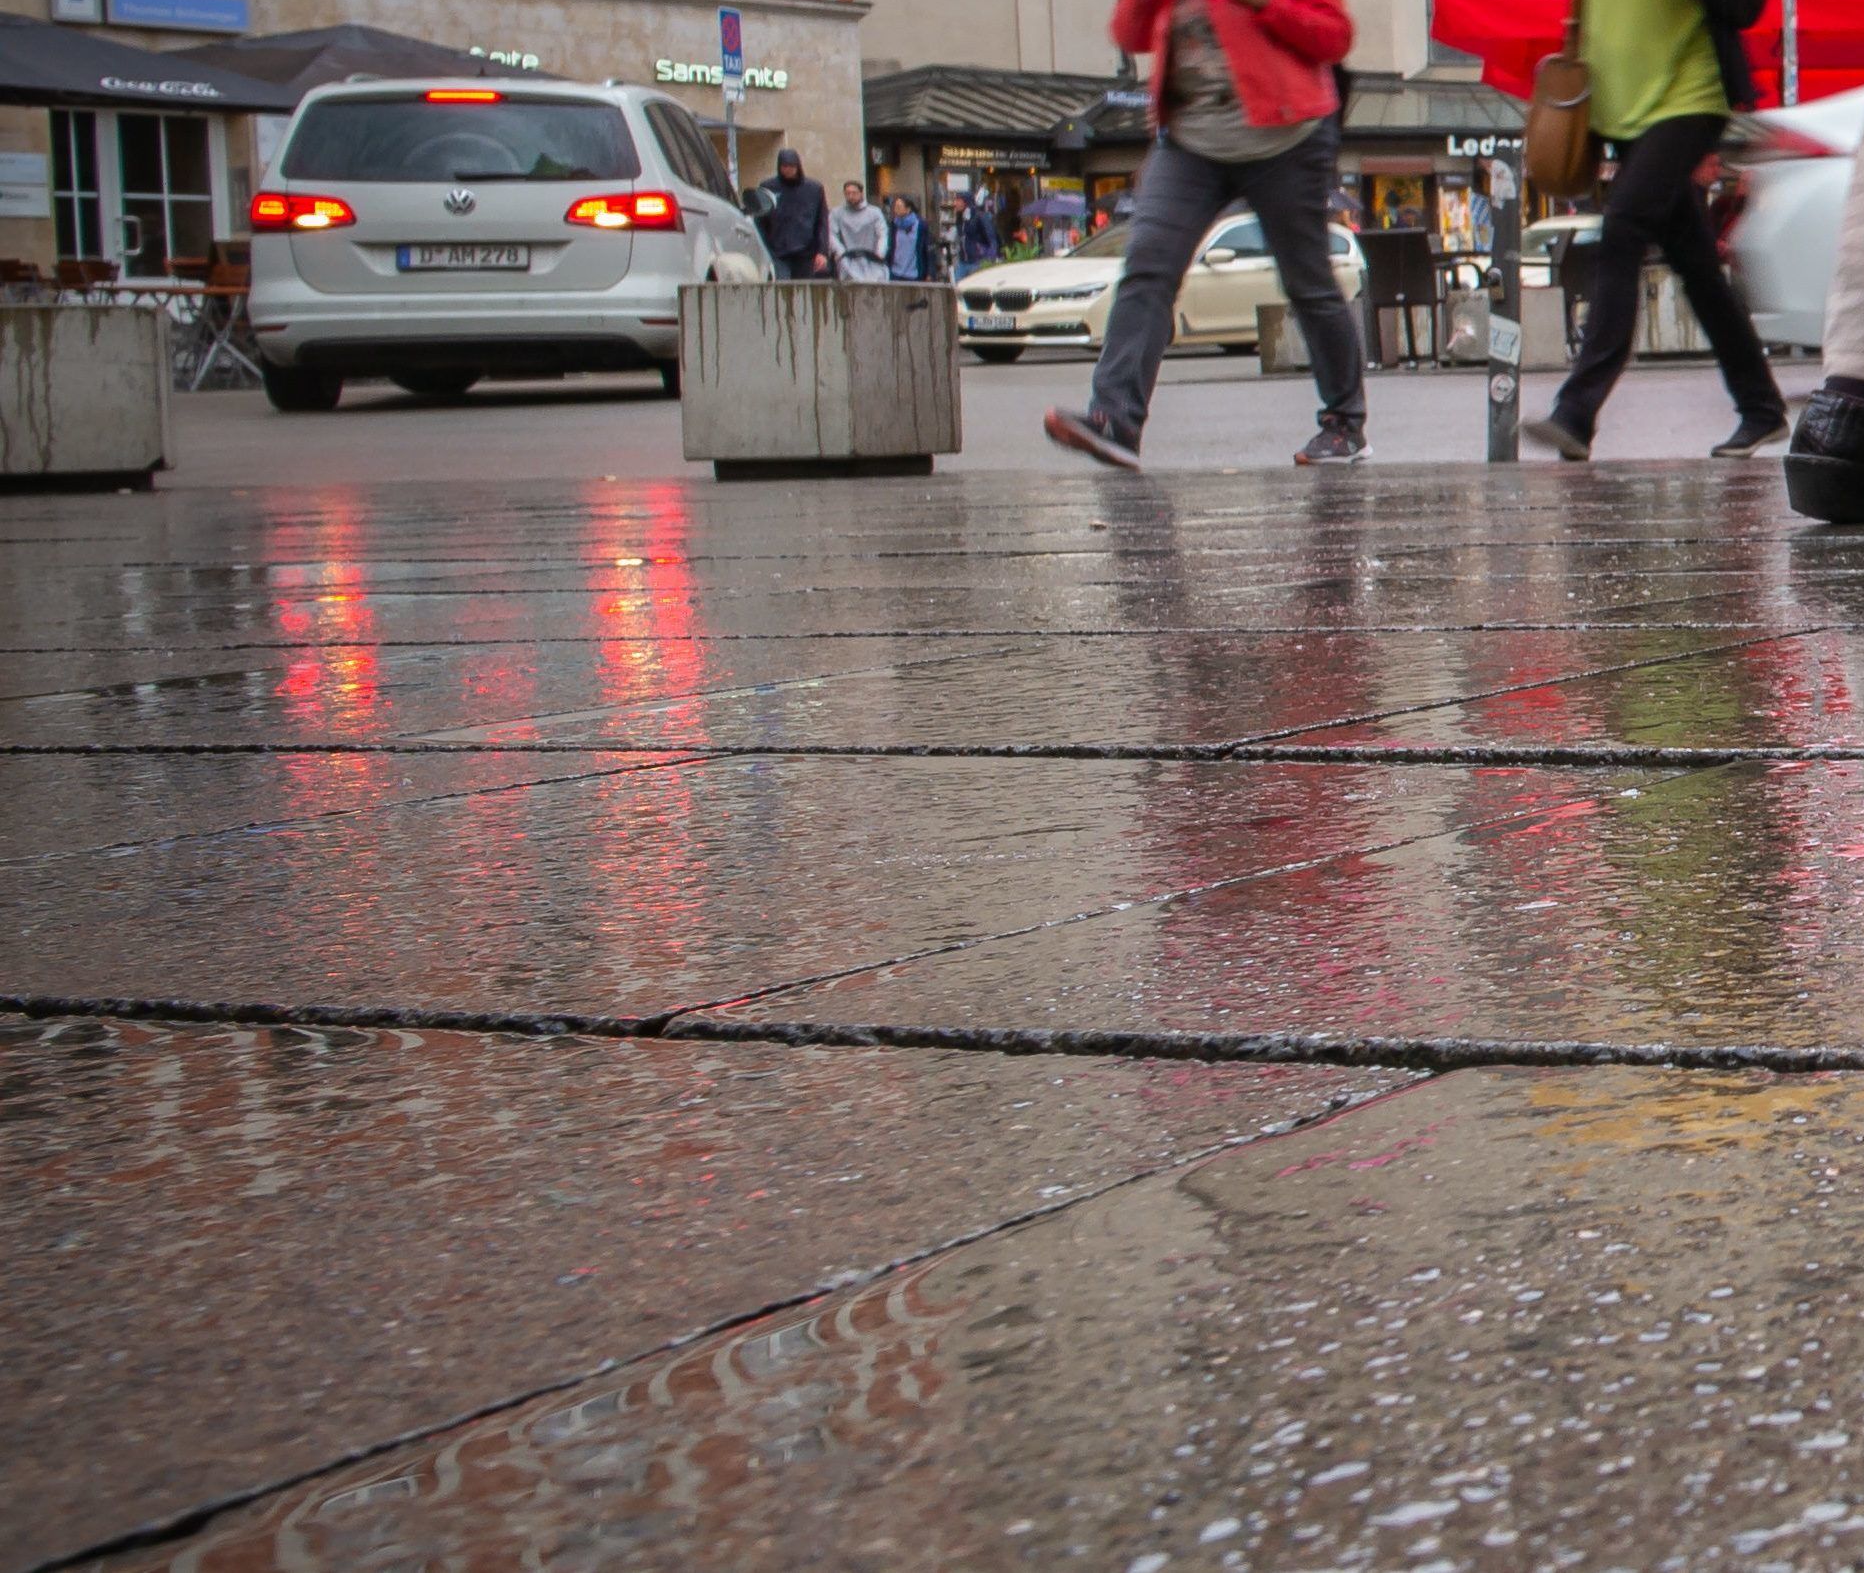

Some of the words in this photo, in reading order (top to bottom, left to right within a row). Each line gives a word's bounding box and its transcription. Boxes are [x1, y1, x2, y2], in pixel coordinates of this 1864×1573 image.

[724, 55, 742, 71] TAXI
[655, 58, 788, 90] Samsnite
[480, 246, 520, 264] 278
